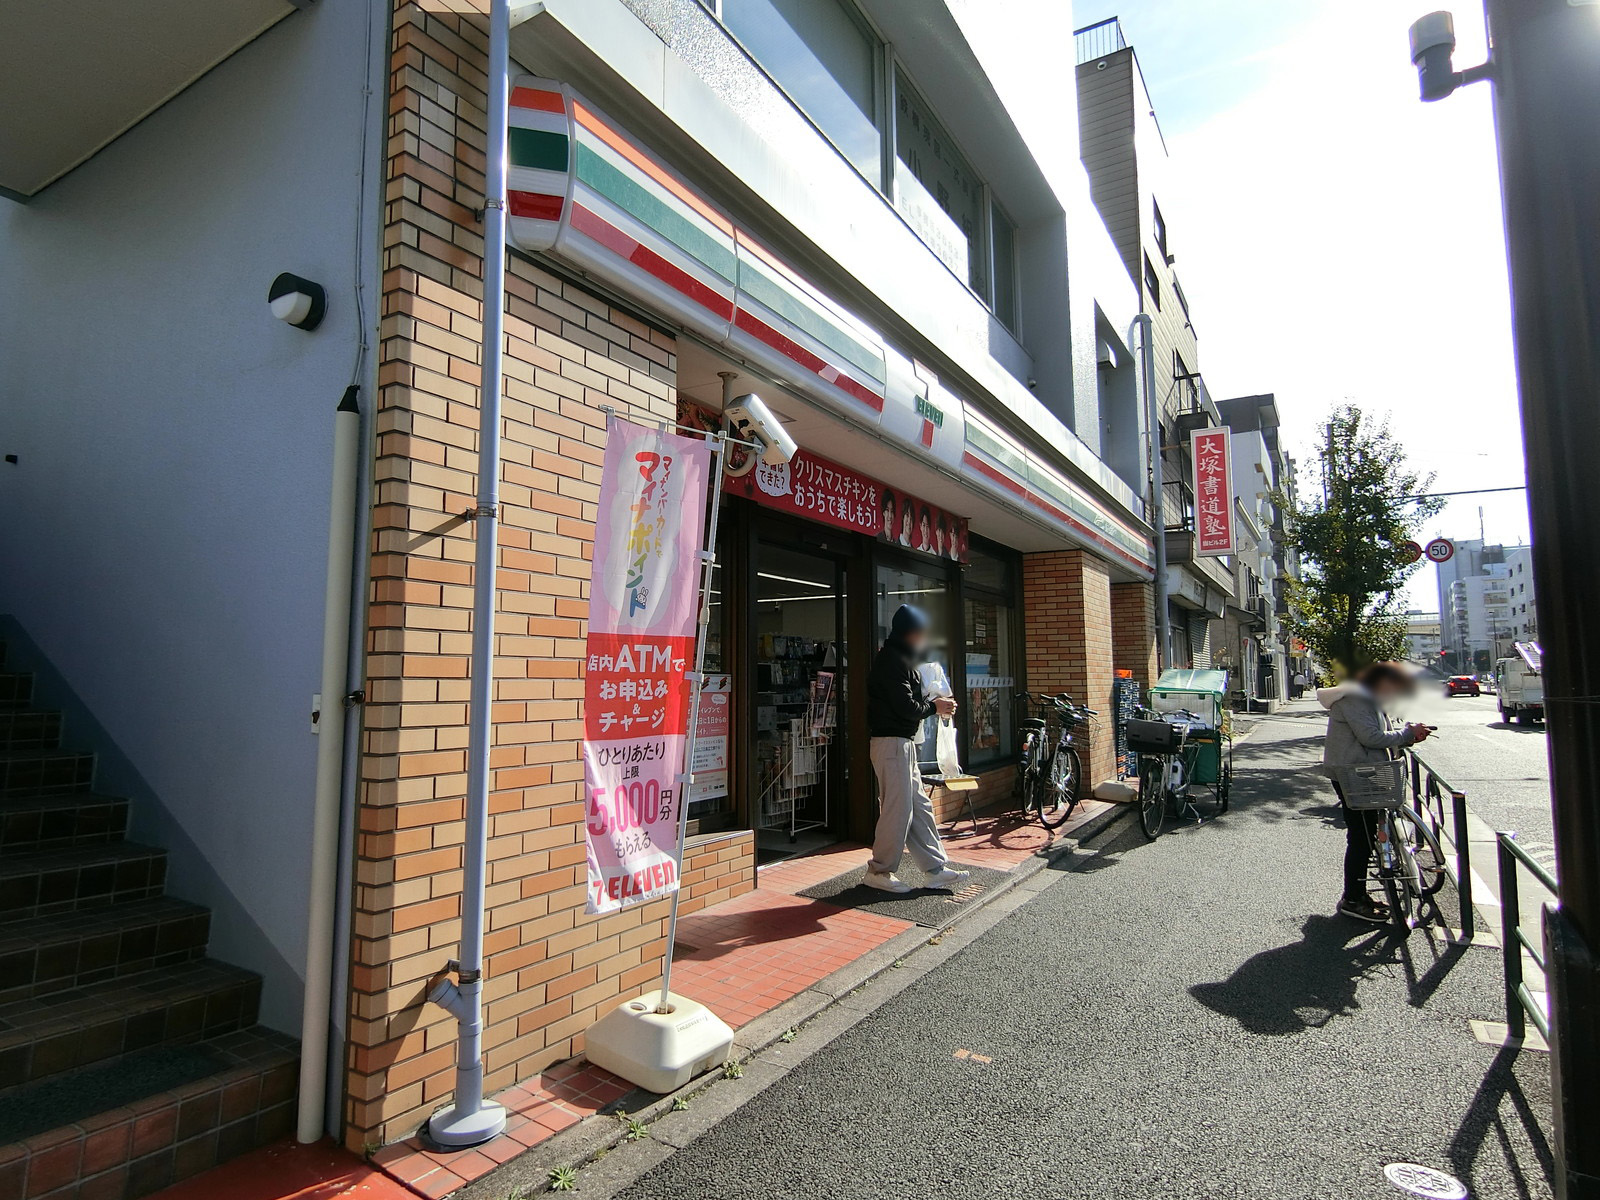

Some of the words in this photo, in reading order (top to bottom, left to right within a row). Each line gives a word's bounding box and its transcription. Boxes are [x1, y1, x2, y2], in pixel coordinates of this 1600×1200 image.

[794, 455, 877, 507] クリスマスチキンを
[1199, 437, 1227, 537] 大塚書道塾
[654, 455, 673, 558] マイナンバーカードで
[626, 451, 661, 618] マイナポイント
[1431, 545, 1447, 556] 50
[599, 679, 669, 703] お申込み
[598, 706, 666, 734] チャージ
[632, 703, 641, 715] &
[598, 744, 666, 766] ひとりあたり
[622, 765, 640, 780] 上限
[588, 779, 659, 836] 5,000
[614, 831, 652, 859] もらえる
